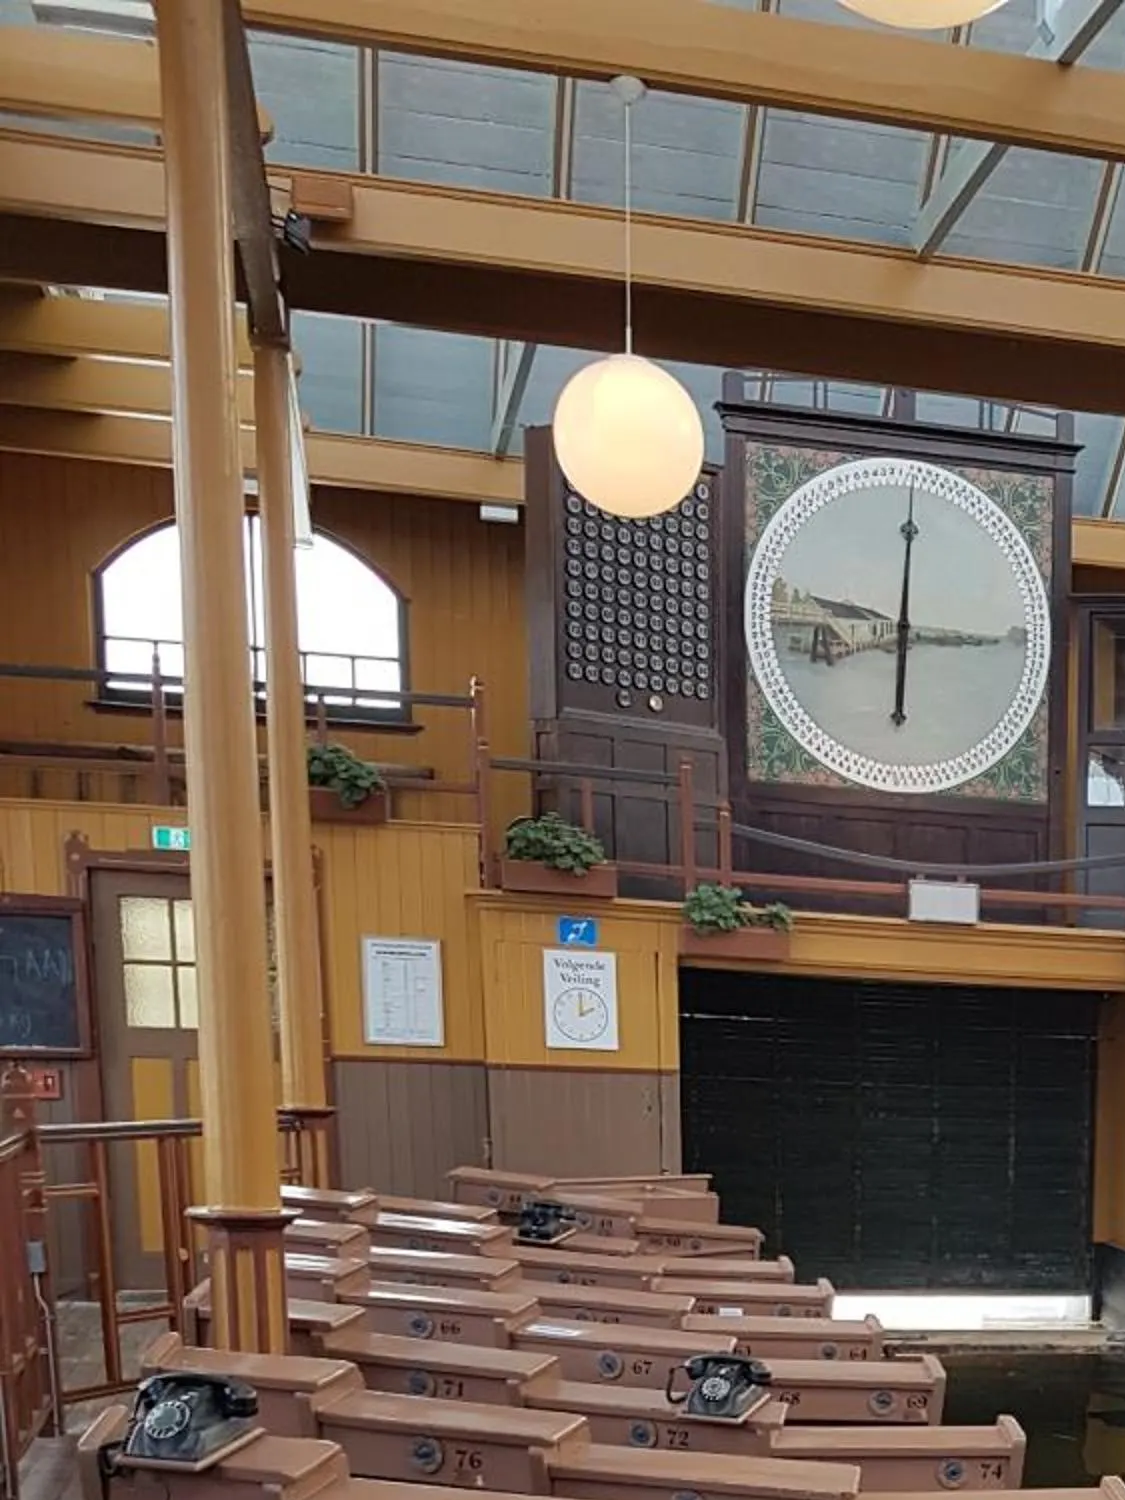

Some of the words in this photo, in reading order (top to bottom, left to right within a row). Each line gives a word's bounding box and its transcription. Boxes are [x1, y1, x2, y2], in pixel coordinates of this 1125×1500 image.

[553, 958, 606, 972] Volgende
[559, 973, 602, 988] Veiling
[440, 1322, 461, 1336] 66
[632, 1360, 653, 1375] 67
[442, 1379, 464, 1397] 71
[666, 1429, 690, 1447] 72
[455, 1450, 483, 1470] 76
[980, 1463, 1002, 1480] 74
